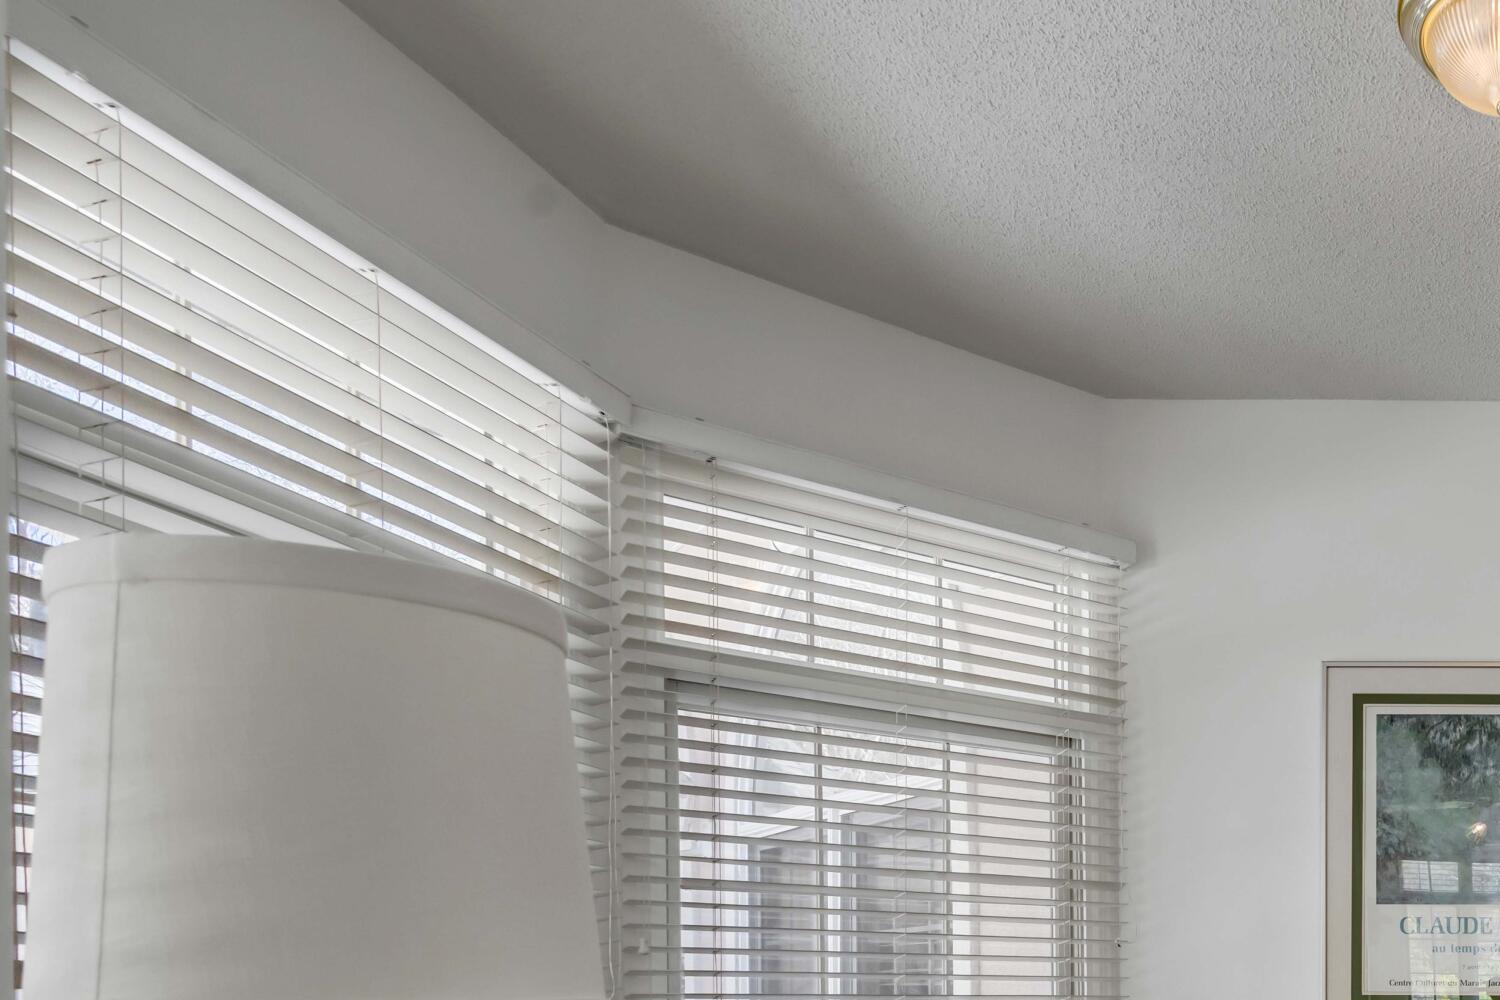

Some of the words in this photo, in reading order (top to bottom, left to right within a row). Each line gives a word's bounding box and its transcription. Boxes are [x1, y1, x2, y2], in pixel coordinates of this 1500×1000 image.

[1400, 916, 1492, 935] CLAUDE
[1432, 945, 1446, 953] au
[1450, 943, 1486, 956] temps
[1460, 979, 1486, 987] Mara
